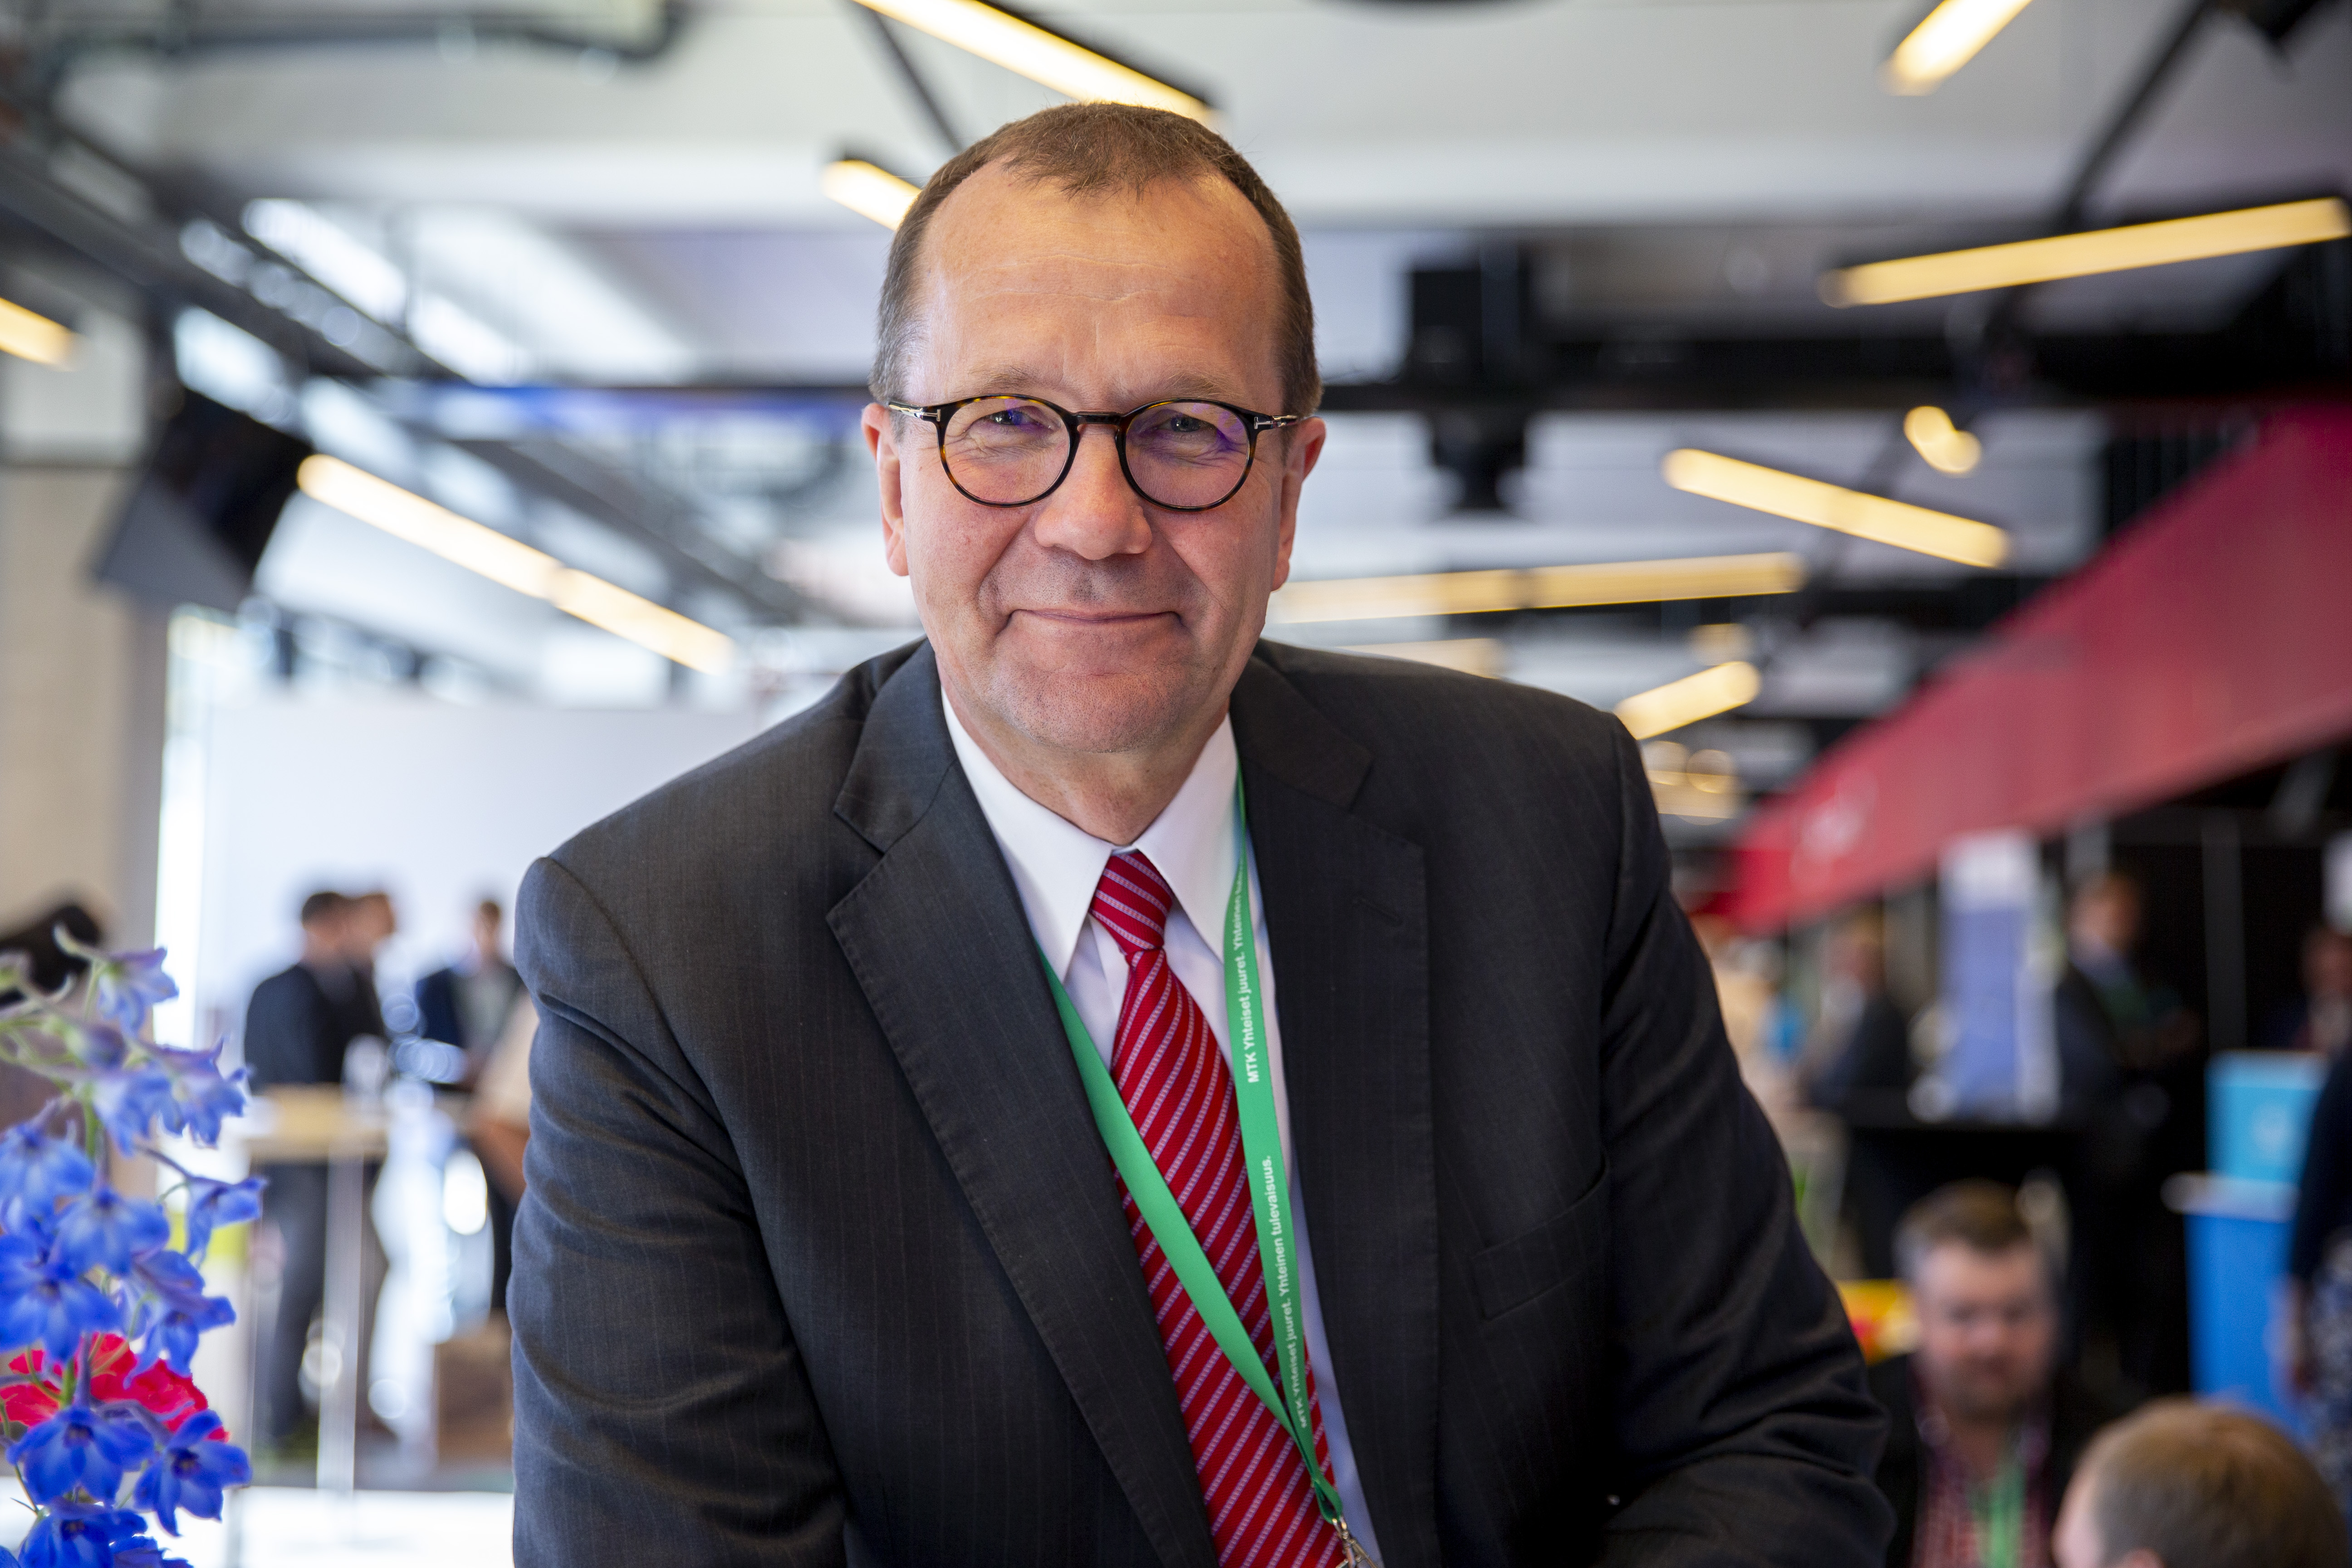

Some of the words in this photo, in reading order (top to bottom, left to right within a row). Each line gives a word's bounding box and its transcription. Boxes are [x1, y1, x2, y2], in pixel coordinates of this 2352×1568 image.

[1235, 952, 1252, 994] juuret.
[1239, 995, 1255, 1050] Yhteiset
[1245, 1051, 1259, 1083] MTK
[1262, 1156, 1283, 1236] tulevaisuus.
[1273, 1237, 1290, 1297] Yhteinen
[1281, 1298, 1298, 1341] juuret.
